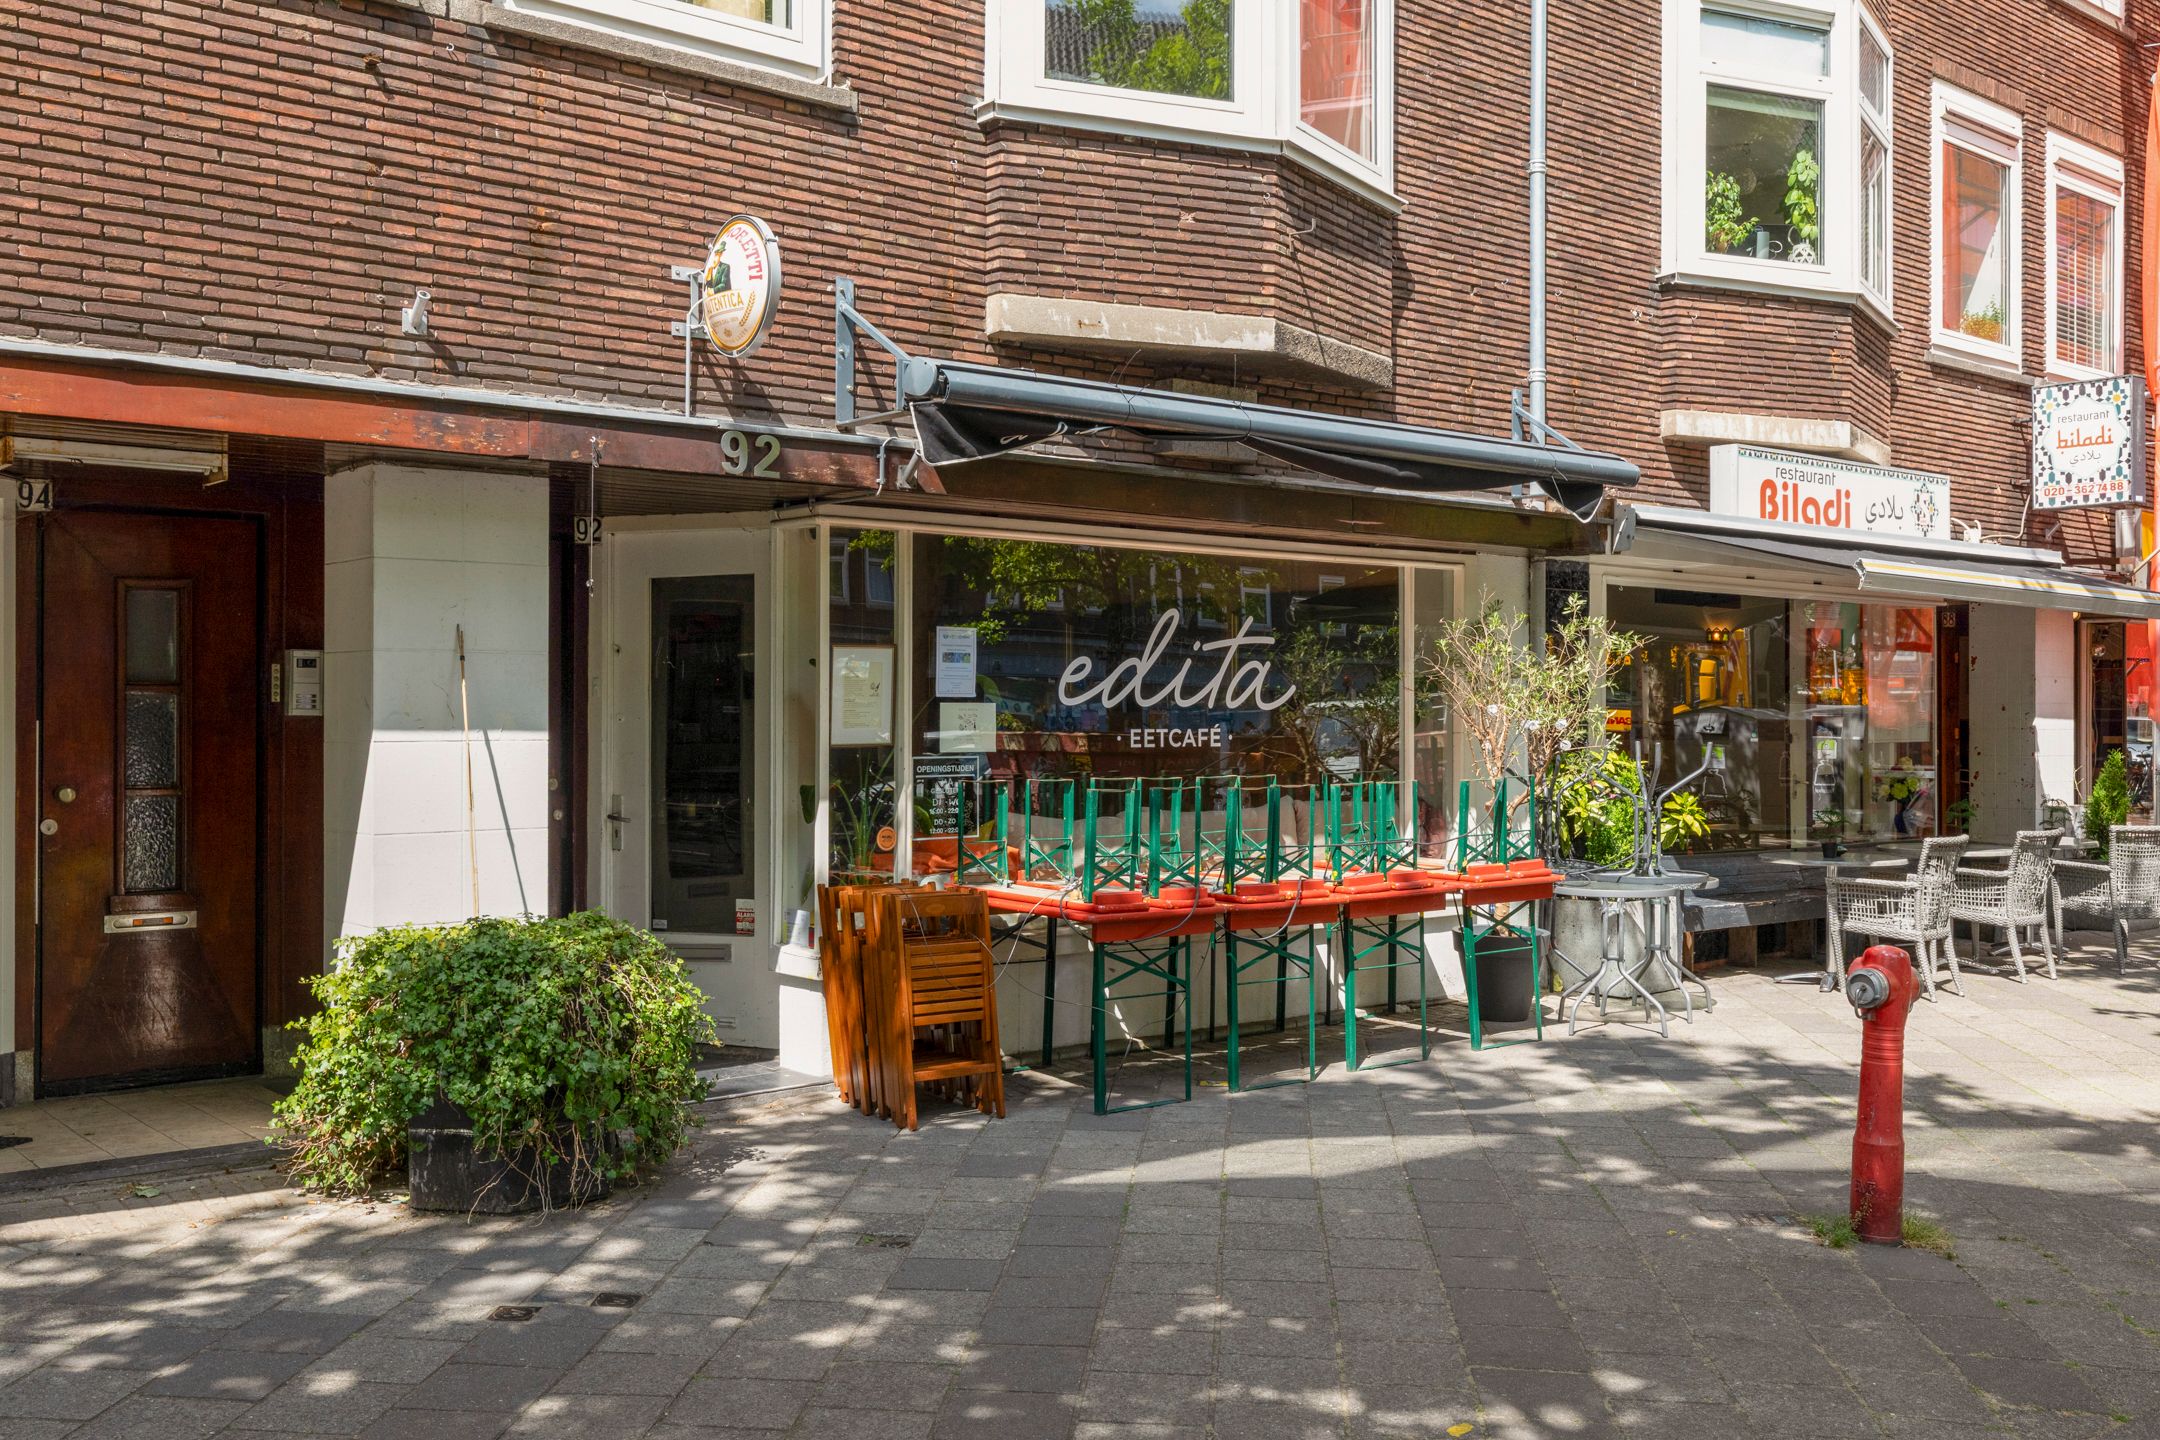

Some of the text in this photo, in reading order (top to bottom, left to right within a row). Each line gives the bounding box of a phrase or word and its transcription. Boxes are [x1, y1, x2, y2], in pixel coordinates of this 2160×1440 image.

[2057, 410, 2110, 424] restaurant
[2056, 424, 2114, 452] biladi
[720, 430, 781, 479] 92
[1775, 466, 1836, 486] restaurant
[18, 481, 50, 508] 94
[1760, 478, 1851, 529] Biladi
[1865, 495, 1904, 531] بلادي
[576, 518, 602, 541] 92
[1058, 608, 1297, 711] edita
[1130, 724, 1222, 748] EETCAFÉ
[916, 765, 974, 773] OPENINGSTIJDEN
